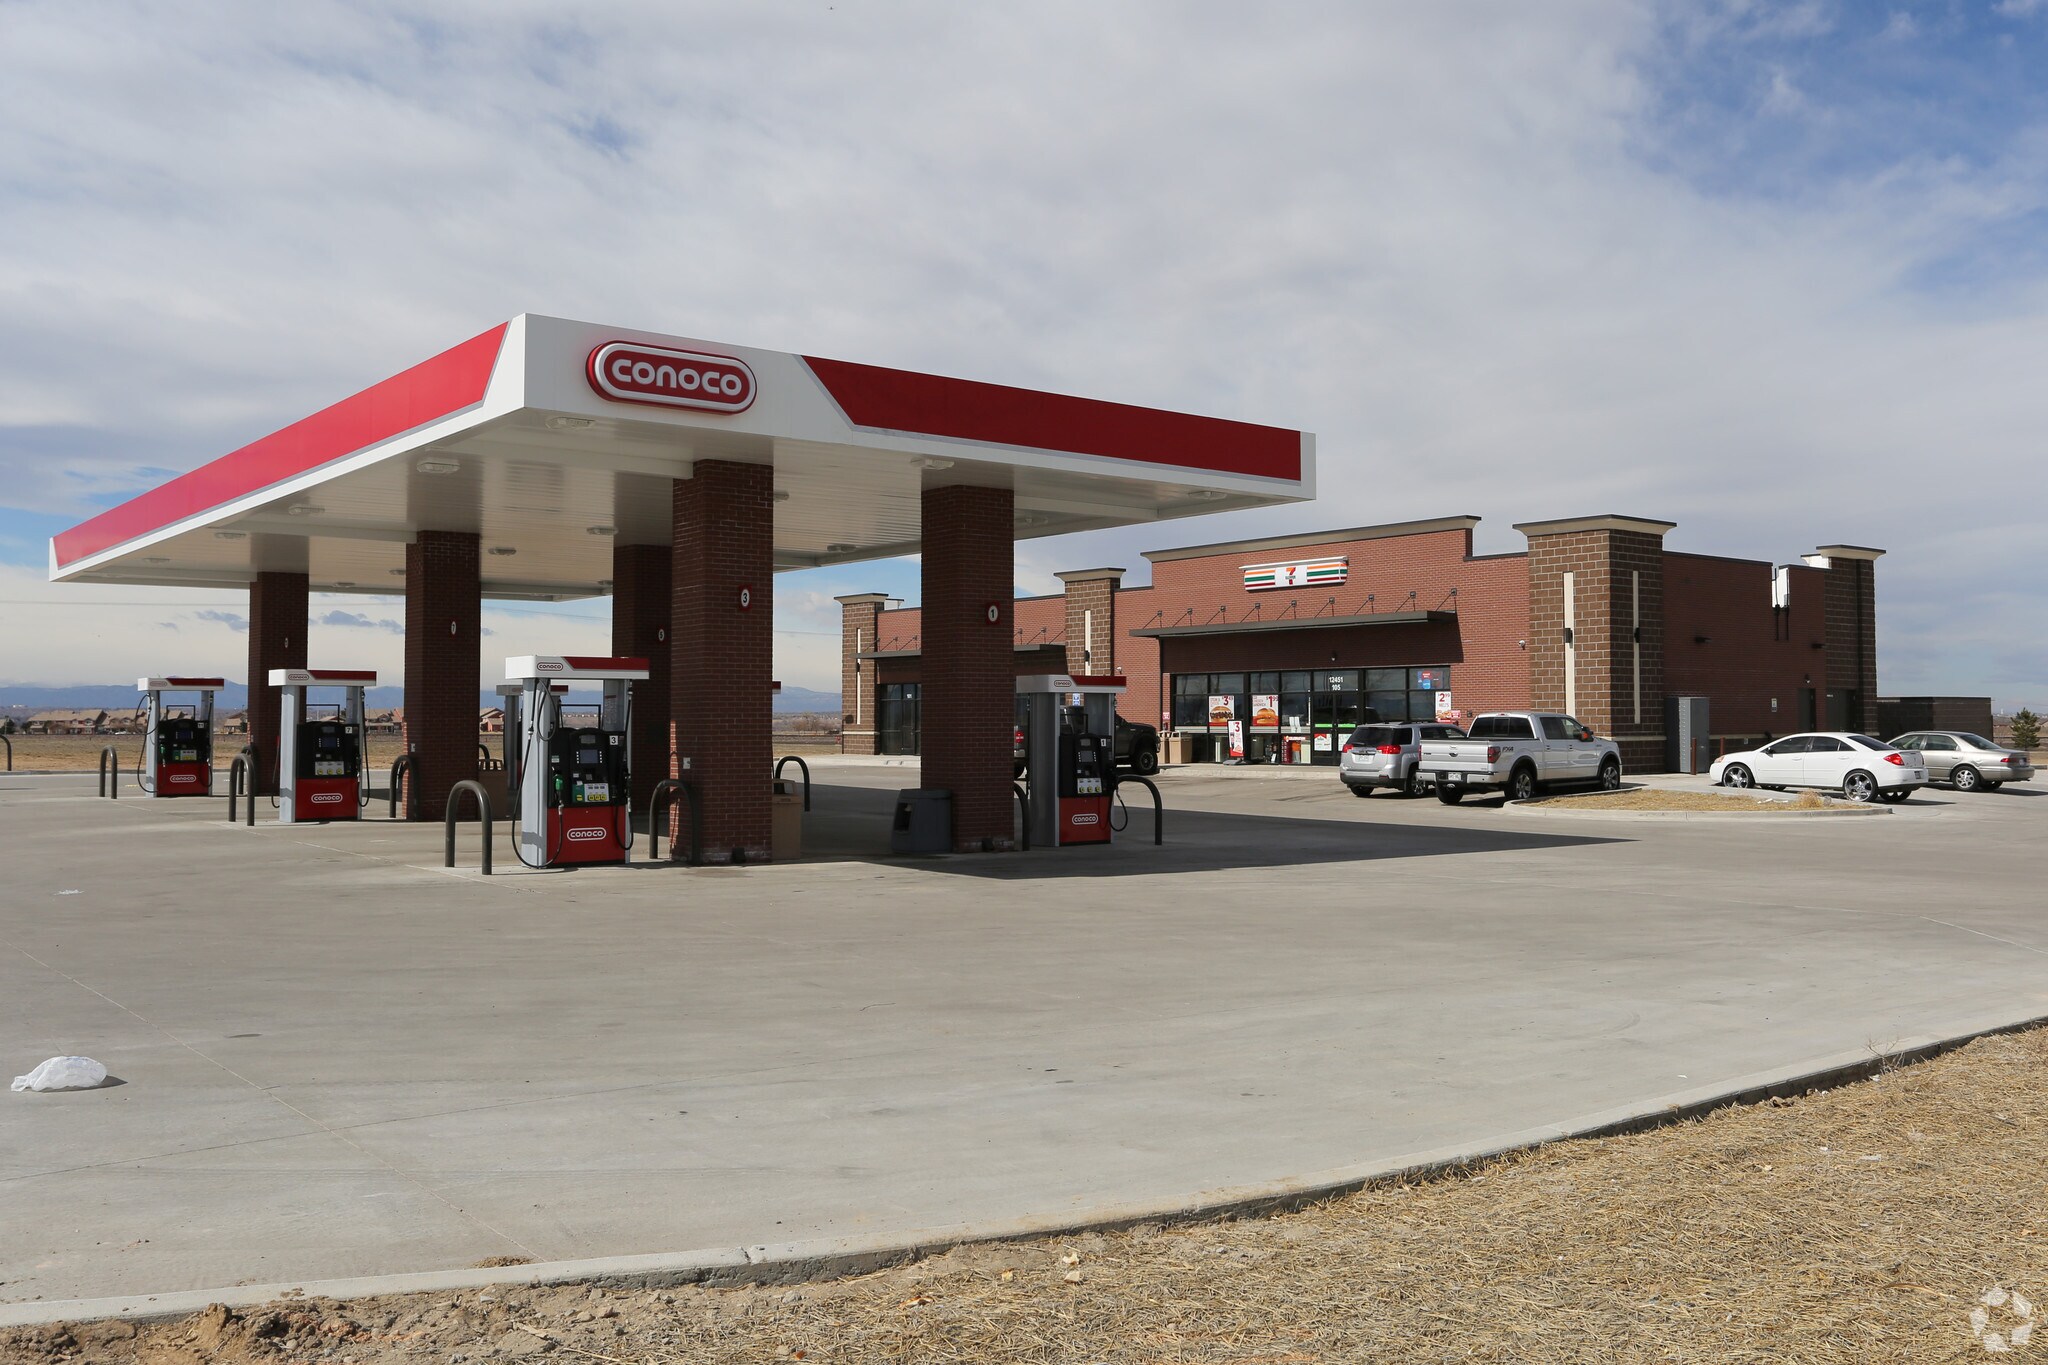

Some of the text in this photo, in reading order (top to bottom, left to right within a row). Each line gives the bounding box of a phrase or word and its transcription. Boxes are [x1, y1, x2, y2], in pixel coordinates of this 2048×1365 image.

[743, 592, 748, 603] 3
[990, 608, 995, 619] 1
[611, 736, 617, 744] 3
